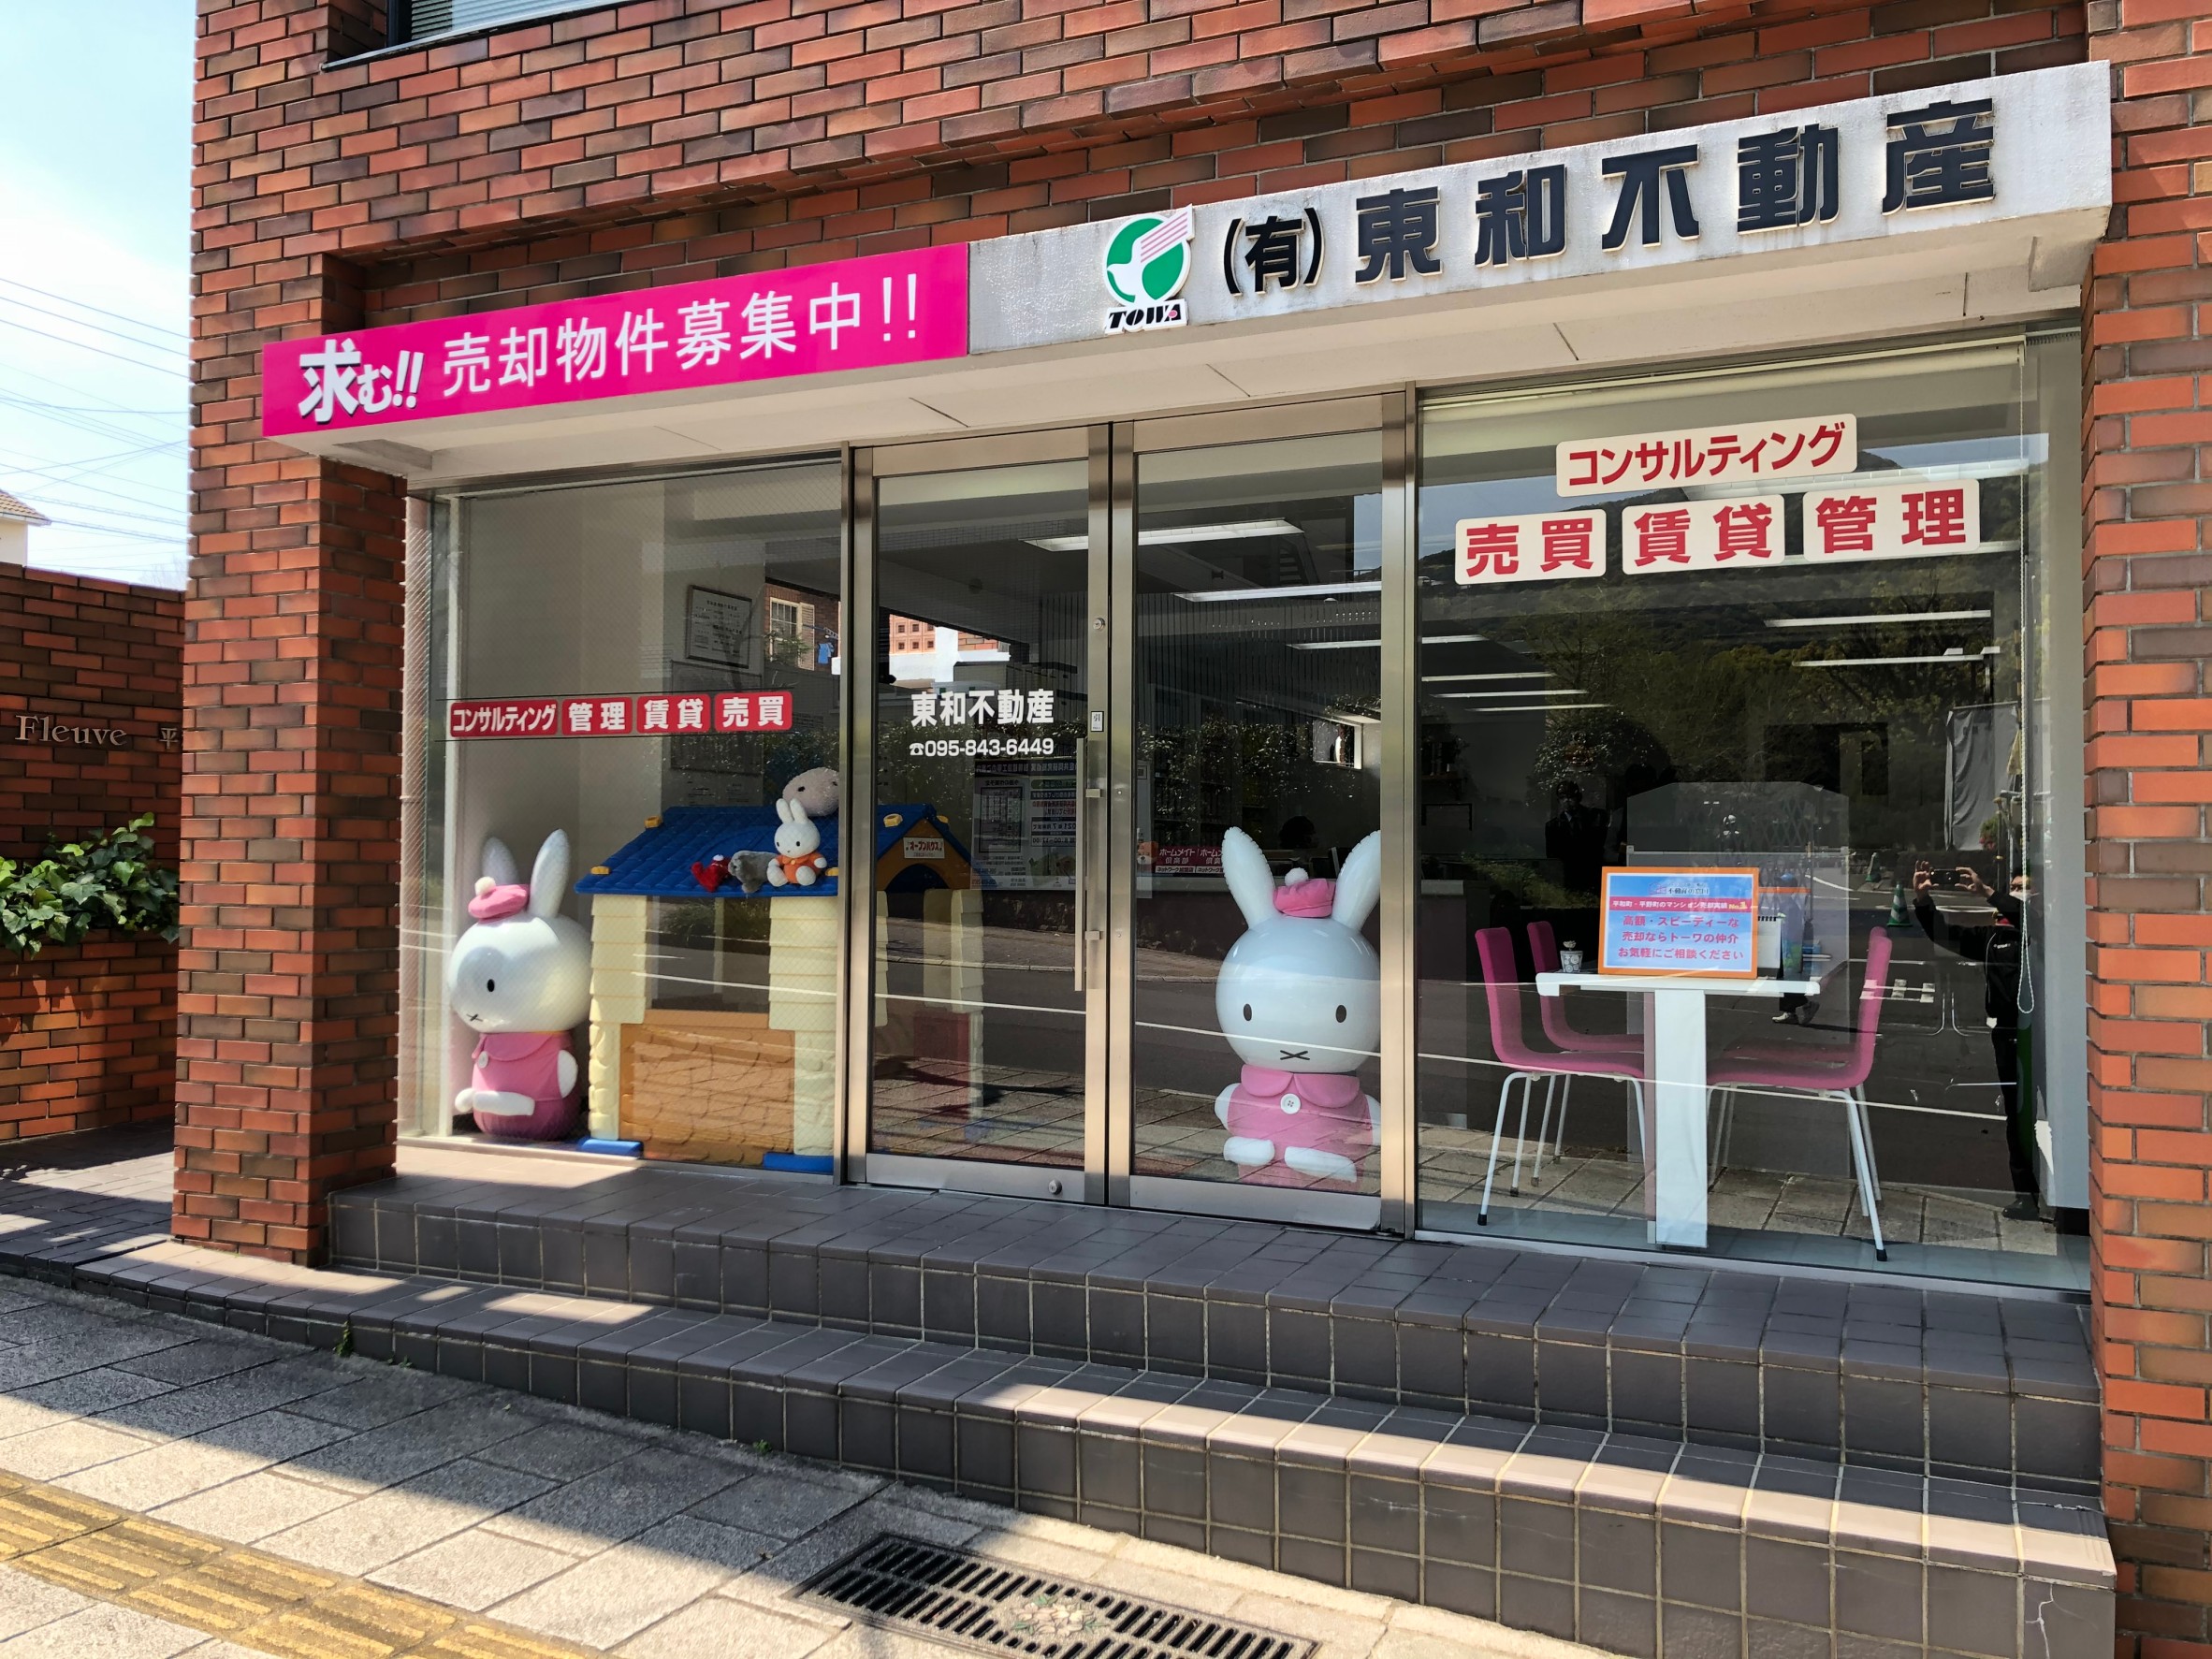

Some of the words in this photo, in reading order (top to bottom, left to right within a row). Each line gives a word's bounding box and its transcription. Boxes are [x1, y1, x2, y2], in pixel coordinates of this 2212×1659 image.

[1109, 303, 1182, 329] TOWA
[1568, 421, 1846, 487] コンサルティング
[1465, 517, 1594, 578] 売買
[1634, 502, 1773, 567] 賃貸
[1815, 488, 1966, 554] 管理
[452, 704, 557, 733] コンサルティング
[568, 701, 626, 733] 管理
[644, 698, 704, 731] 賃貸
[722, 695, 784, 728] 売買
[910, 689, 1055, 727] 東和不動産
[15, 715, 127, 746] Fleuve
[159, 727, 180, 749] 平
[1159, 848, 1196, 856] ホームメイト
[1618, 947, 1744, 961] お気軽にご相談ください
[1622, 932, 1739, 944] 売却ならトーワの仲介
